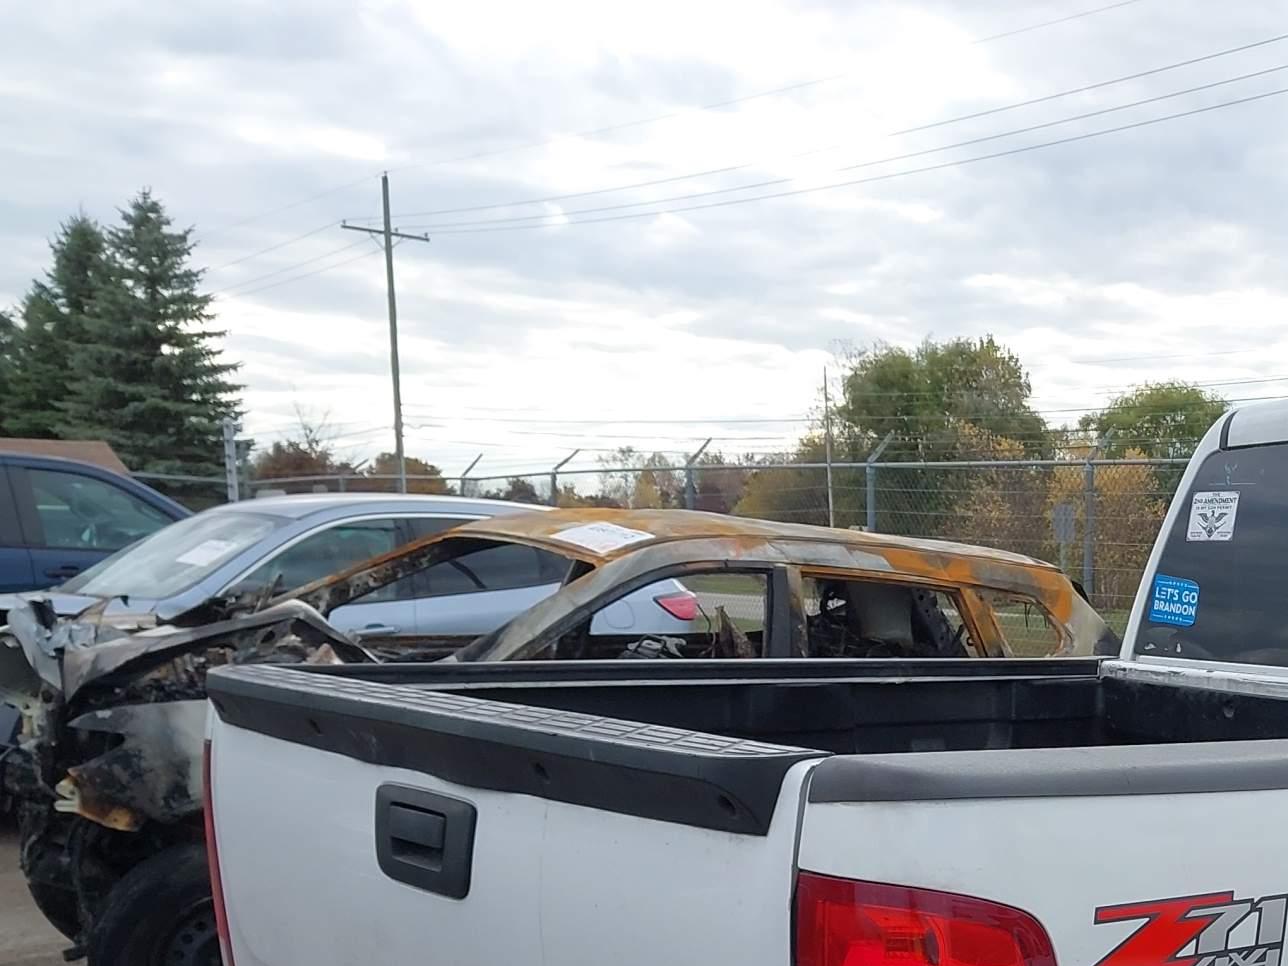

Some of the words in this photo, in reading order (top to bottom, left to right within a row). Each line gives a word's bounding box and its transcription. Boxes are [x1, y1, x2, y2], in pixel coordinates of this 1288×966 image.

[1155, 587, 1178, 600] LET'S
[1182, 591, 1198, 604] GO
[1153, 600, 1196, 617] BRANDON
